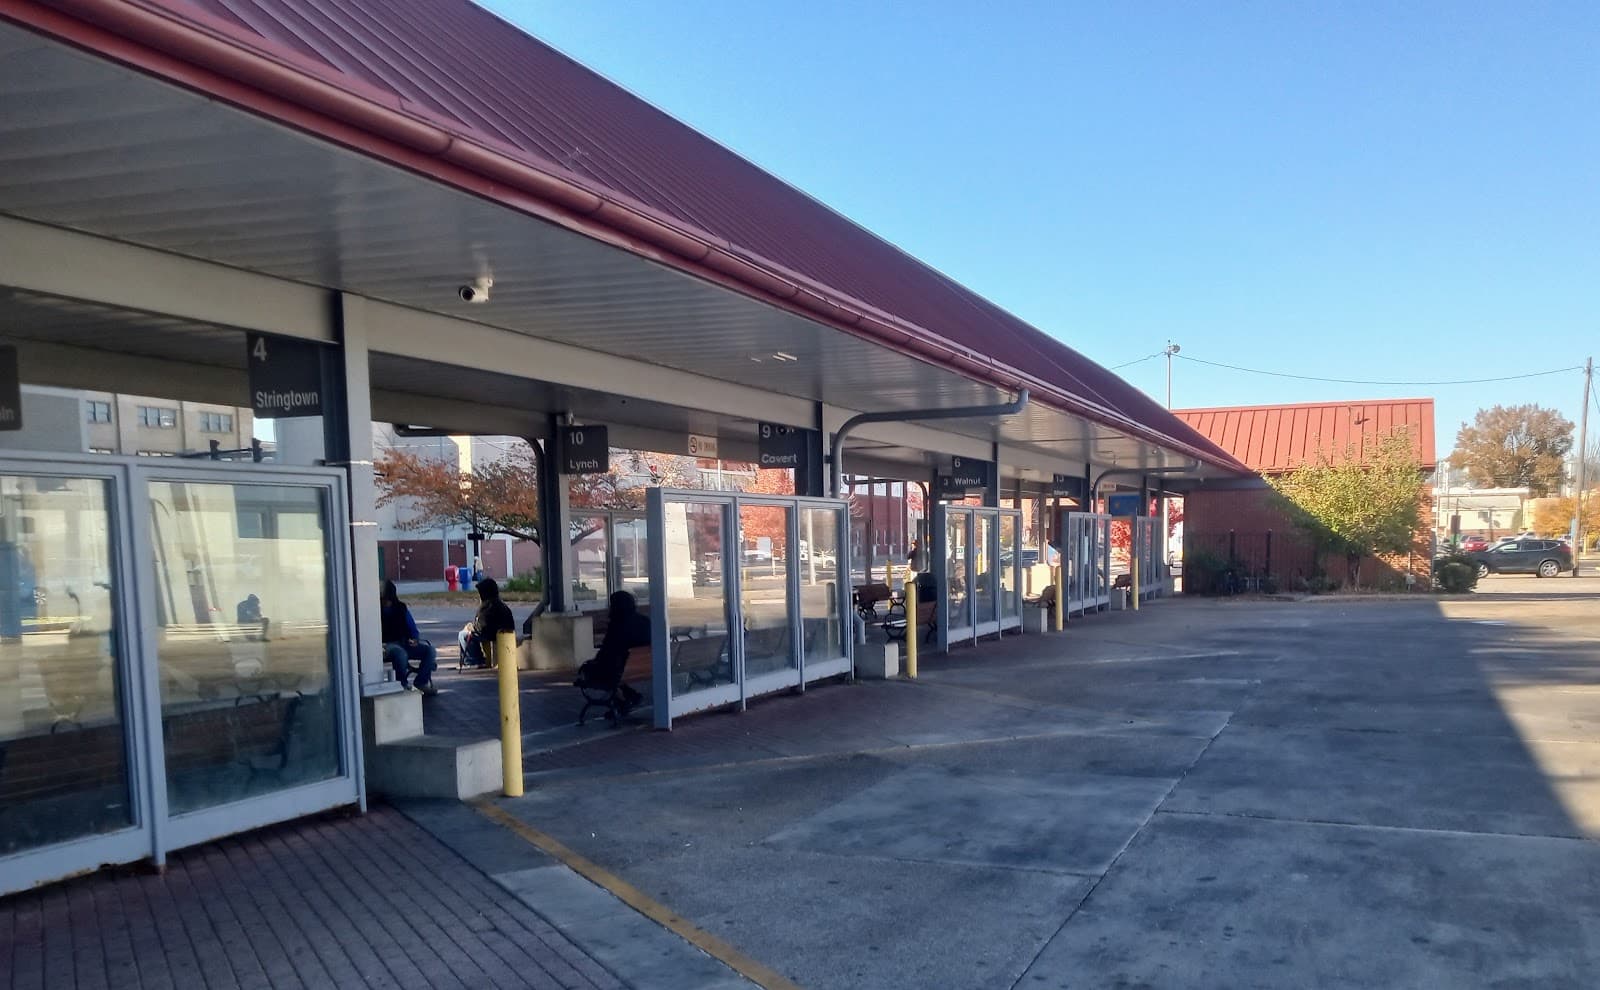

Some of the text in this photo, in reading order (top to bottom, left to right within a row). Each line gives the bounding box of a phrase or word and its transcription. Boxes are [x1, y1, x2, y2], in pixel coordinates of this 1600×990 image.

[253, 337, 267, 362] 4
[256, 390, 319, 412] Stringtown
[569, 431, 584, 445] 10
[762, 424, 771, 439] 9
[569, 458, 599, 471] Lynch
[761, 453, 798, 464] Covert
[954, 457, 961, 469] 6
[954, 476, 981, 486] Walnut
